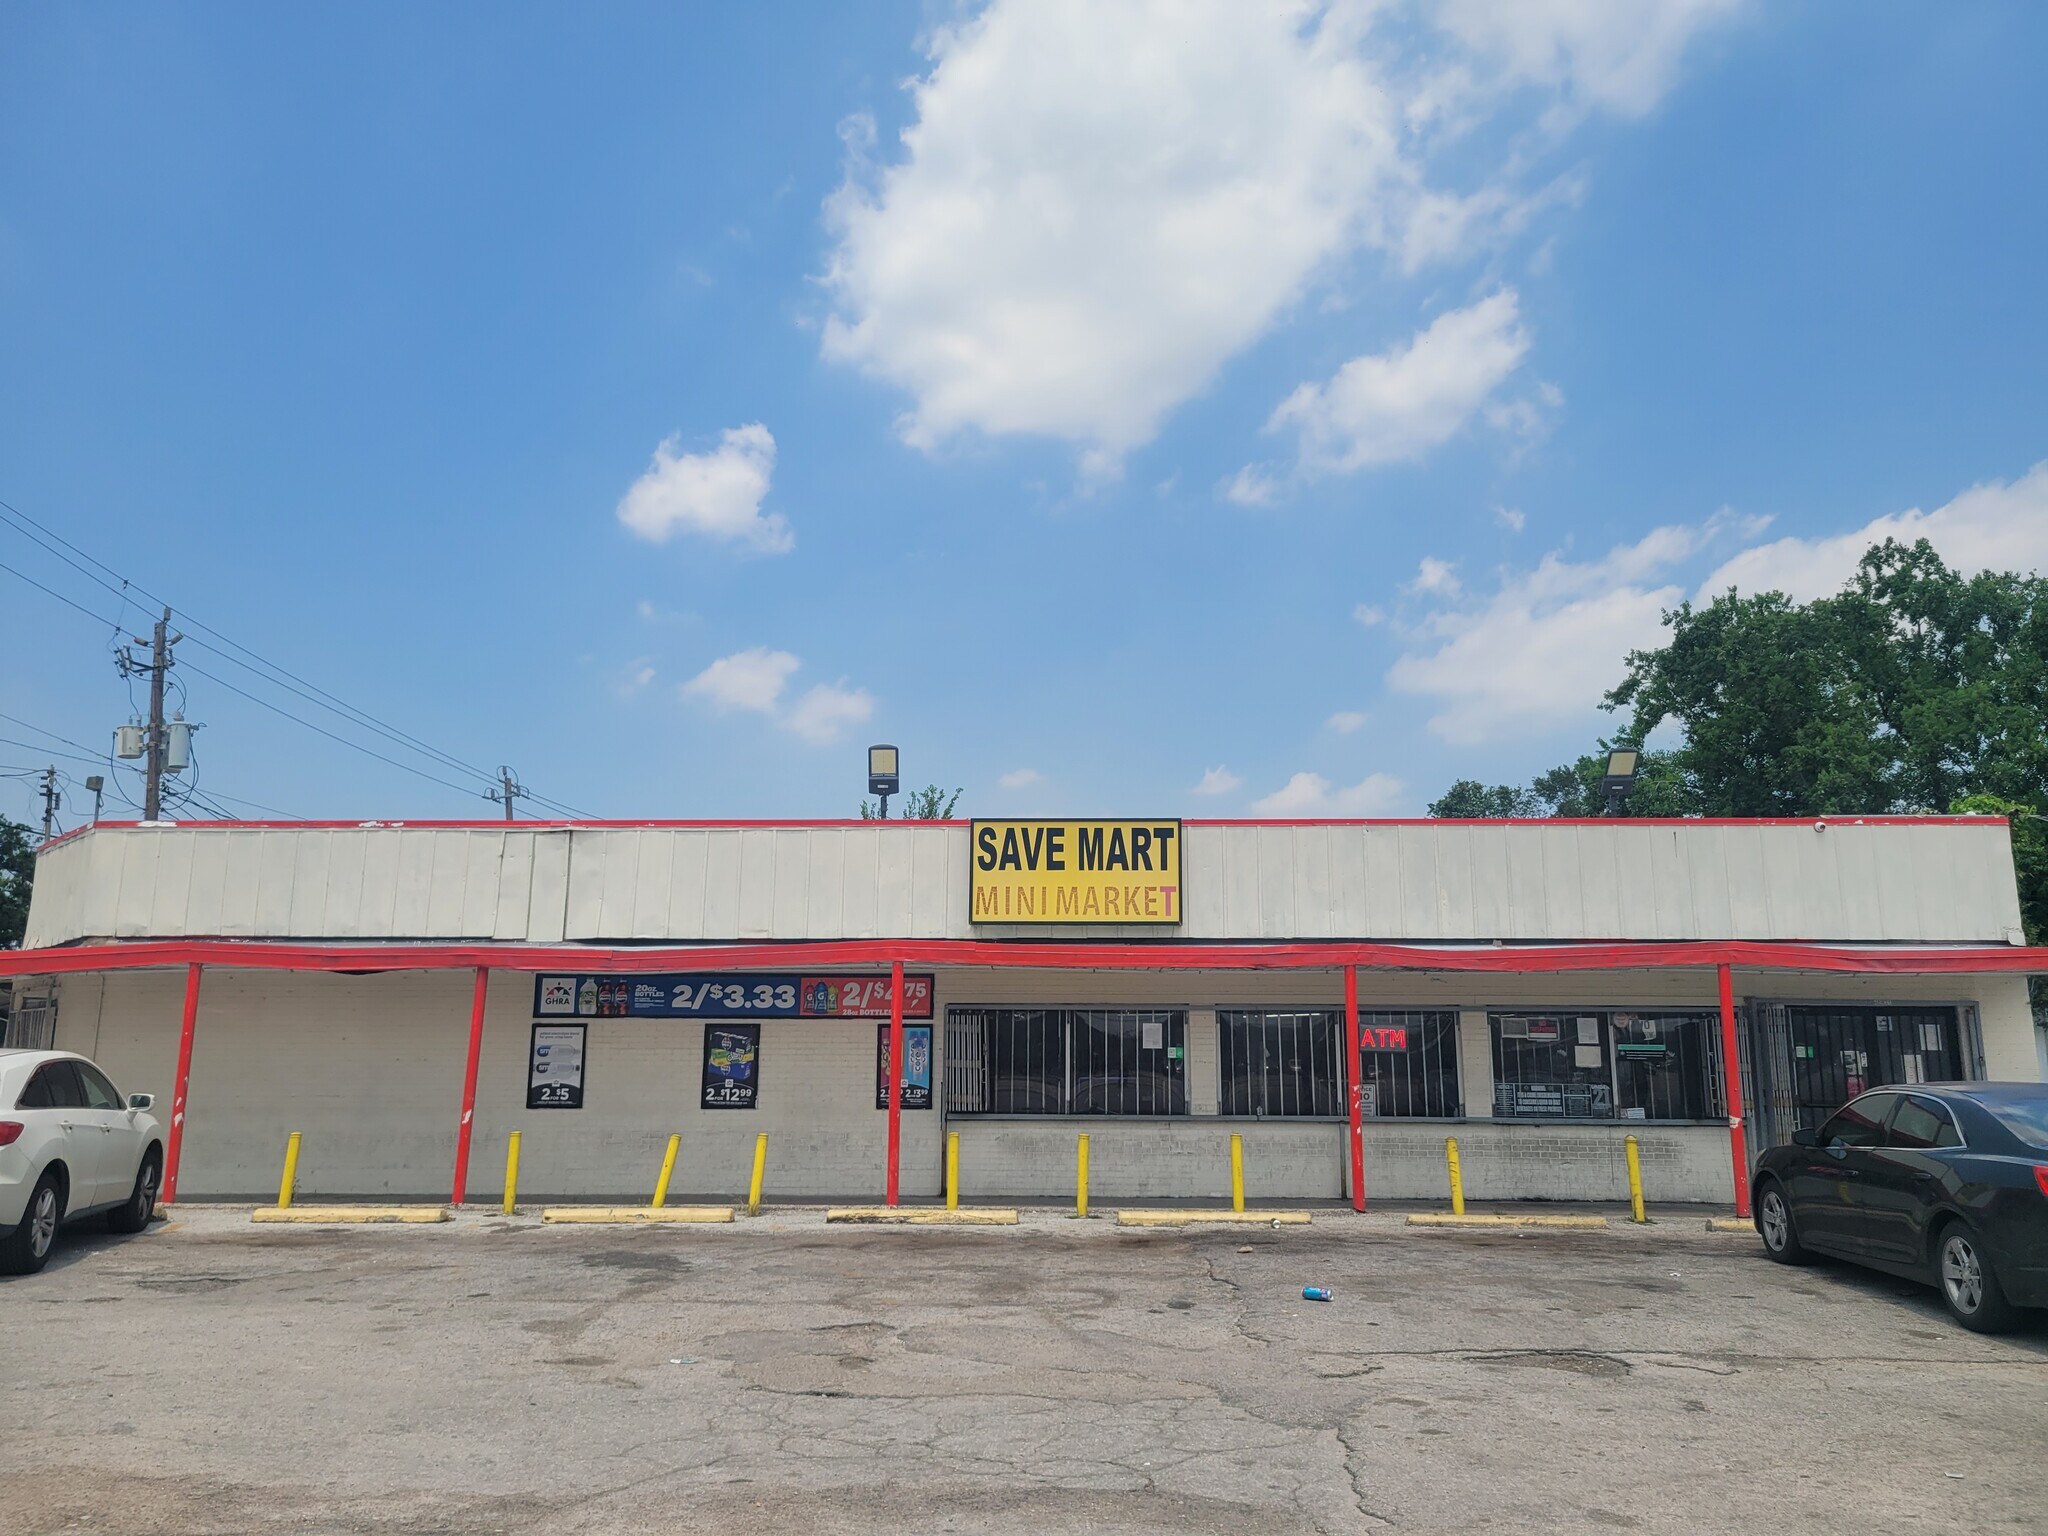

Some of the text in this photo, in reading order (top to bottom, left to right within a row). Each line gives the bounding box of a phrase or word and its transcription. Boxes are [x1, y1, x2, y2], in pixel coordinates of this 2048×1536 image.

[977, 826, 1174, 871] SAVE MART
[975, 886, 1177, 917] MINI MARKET
[545, 997, 570, 1005] GHRA
[672, 983, 796, 1010] 2/$3.33
[817, 992, 825, 1001] G
[1361, 1028, 1406, 1049] ATM
[541, 1088, 551, 1100] 2
[556, 1087, 570, 1101] $5
[705, 1088, 715, 1101] 2
[1592, 1088, 1610, 1104] 21
